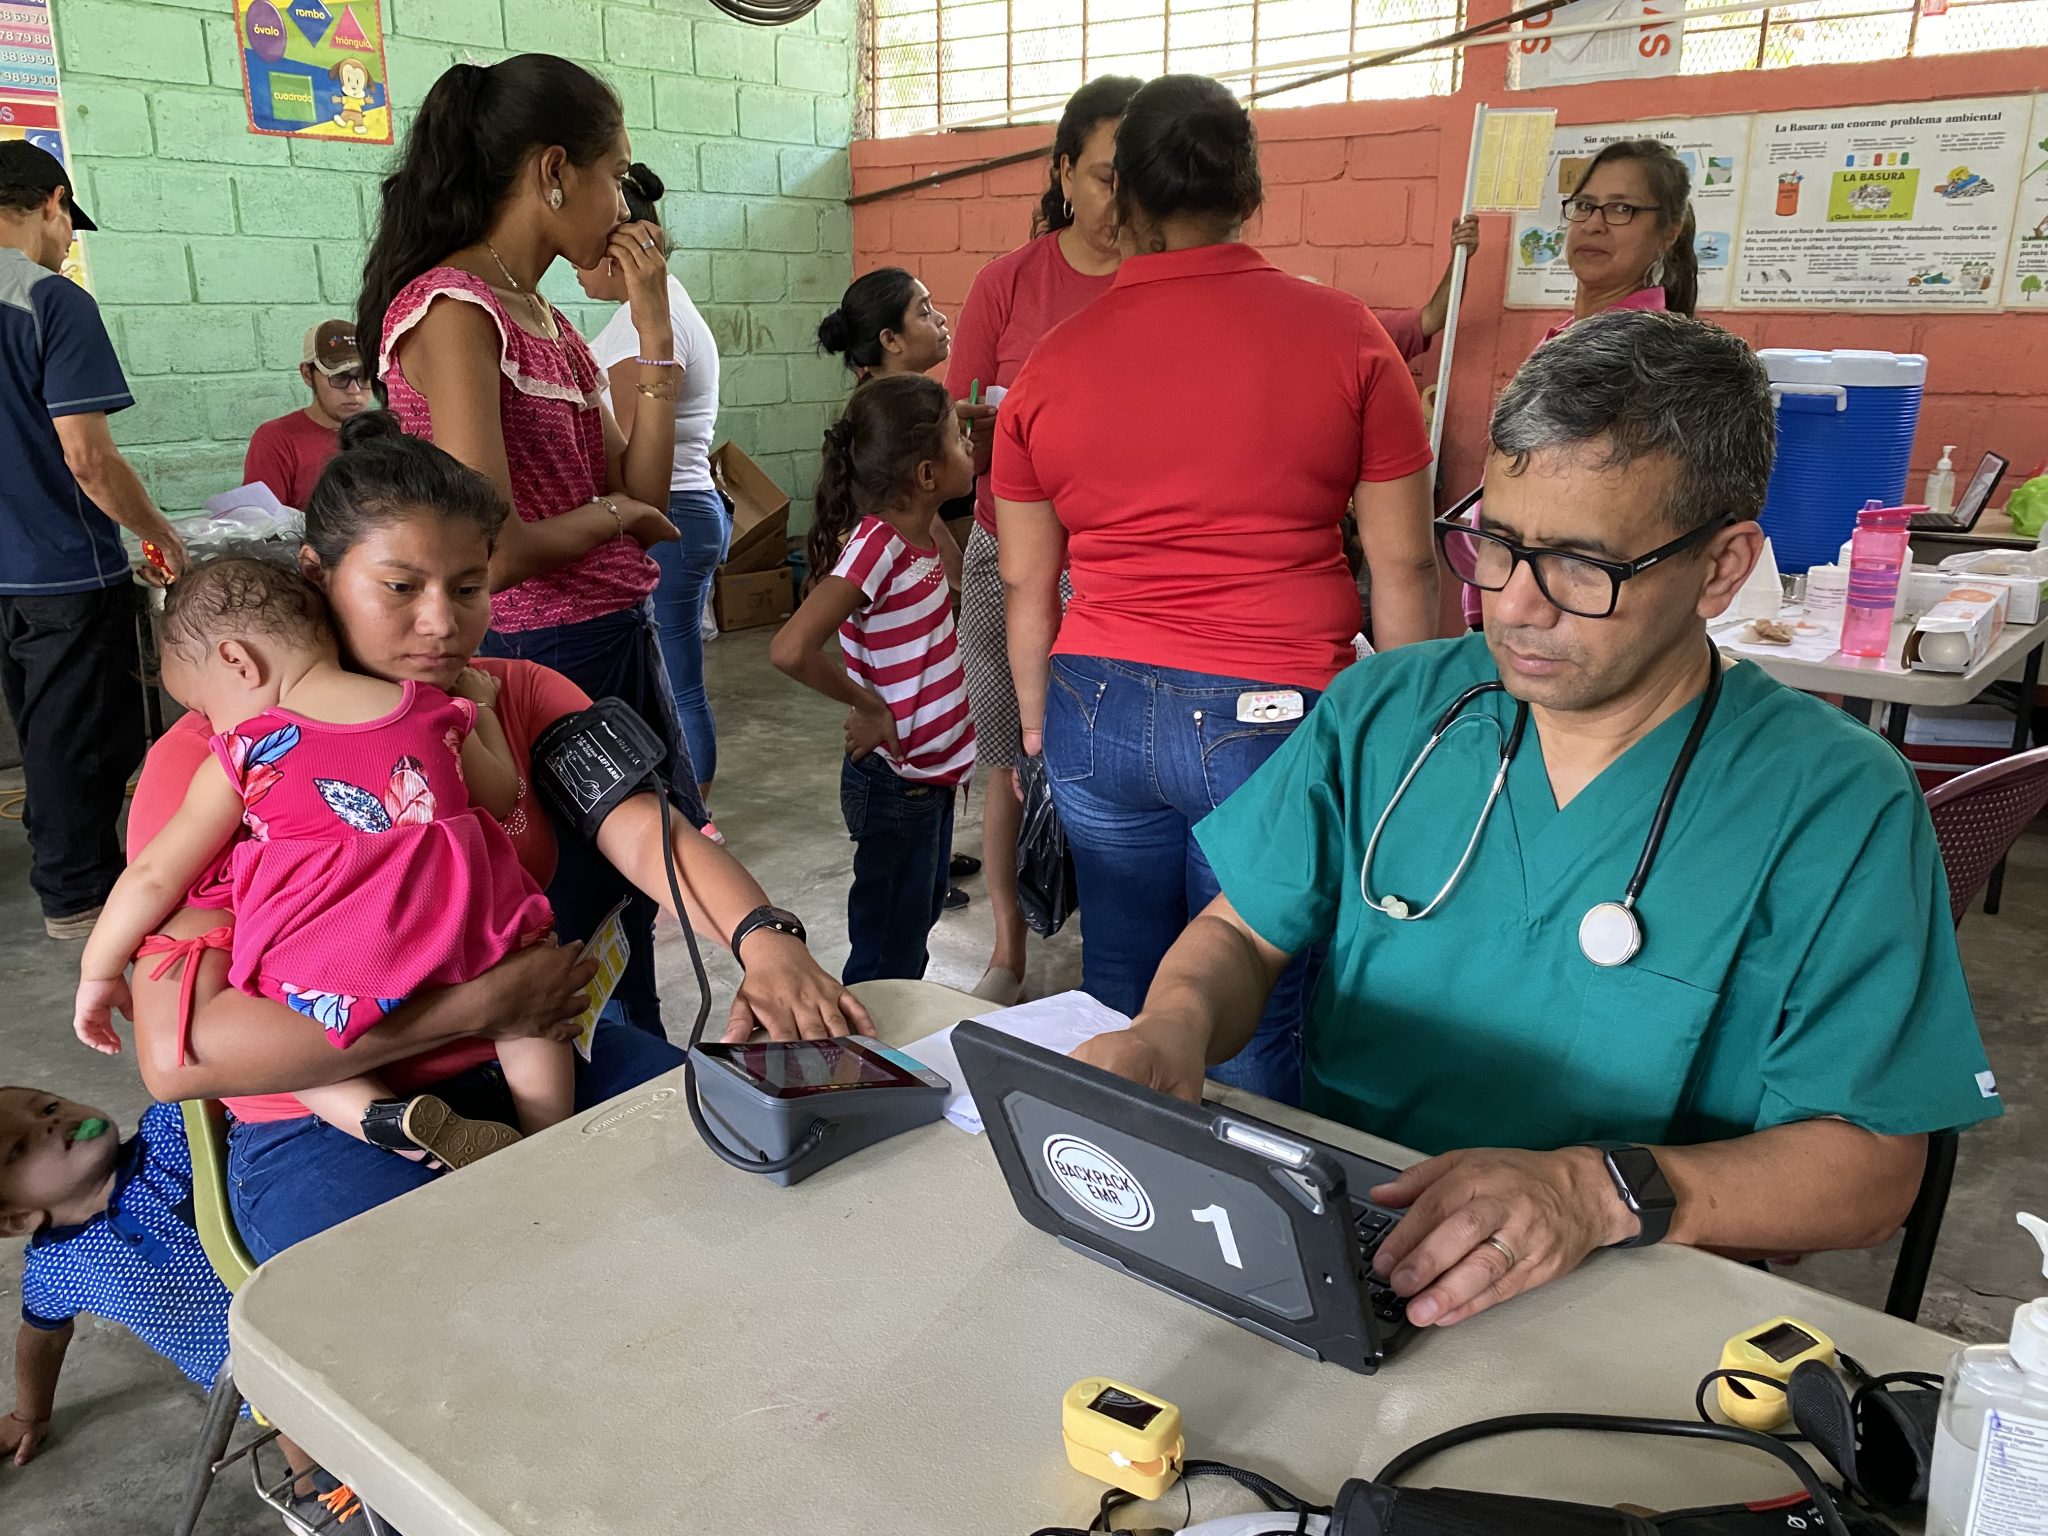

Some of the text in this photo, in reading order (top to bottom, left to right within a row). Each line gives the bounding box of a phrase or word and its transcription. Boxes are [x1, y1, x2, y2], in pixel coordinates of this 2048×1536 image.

[13, 11, 29, 22] 69
[32, 14, 48, 24] 70
[296, 8, 326, 20] rombo
[254, 24, 280, 36] óvalo
[16, 32, 32, 42] 79
[34, 34, 52, 45] 80
[0, 51, 54, 66] 88 89 90
[4, 71, 58, 86] 98 99 100
[274, 92, 313, 103] cuadrado
[0, 106, 14, 122] S
[1776, 124, 1787, 132] La
[1790, 122, 1828, 132] Basura:
[1847, 120, 1887, 128] enorme
[1890, 116, 1942, 128] problema
[1946, 112, 2002, 123] ambiental
[1656, 132, 1676, 140] vida.
[1843, 172, 1906, 182] LA BASURA
[598, 755, 620, 780] LEFT ARM
[1055, 1160, 1136, 1194] BACKPACK
[1086, 1184, 1124, 1206] EMR
[1192, 1204, 1243, 1270] 1
